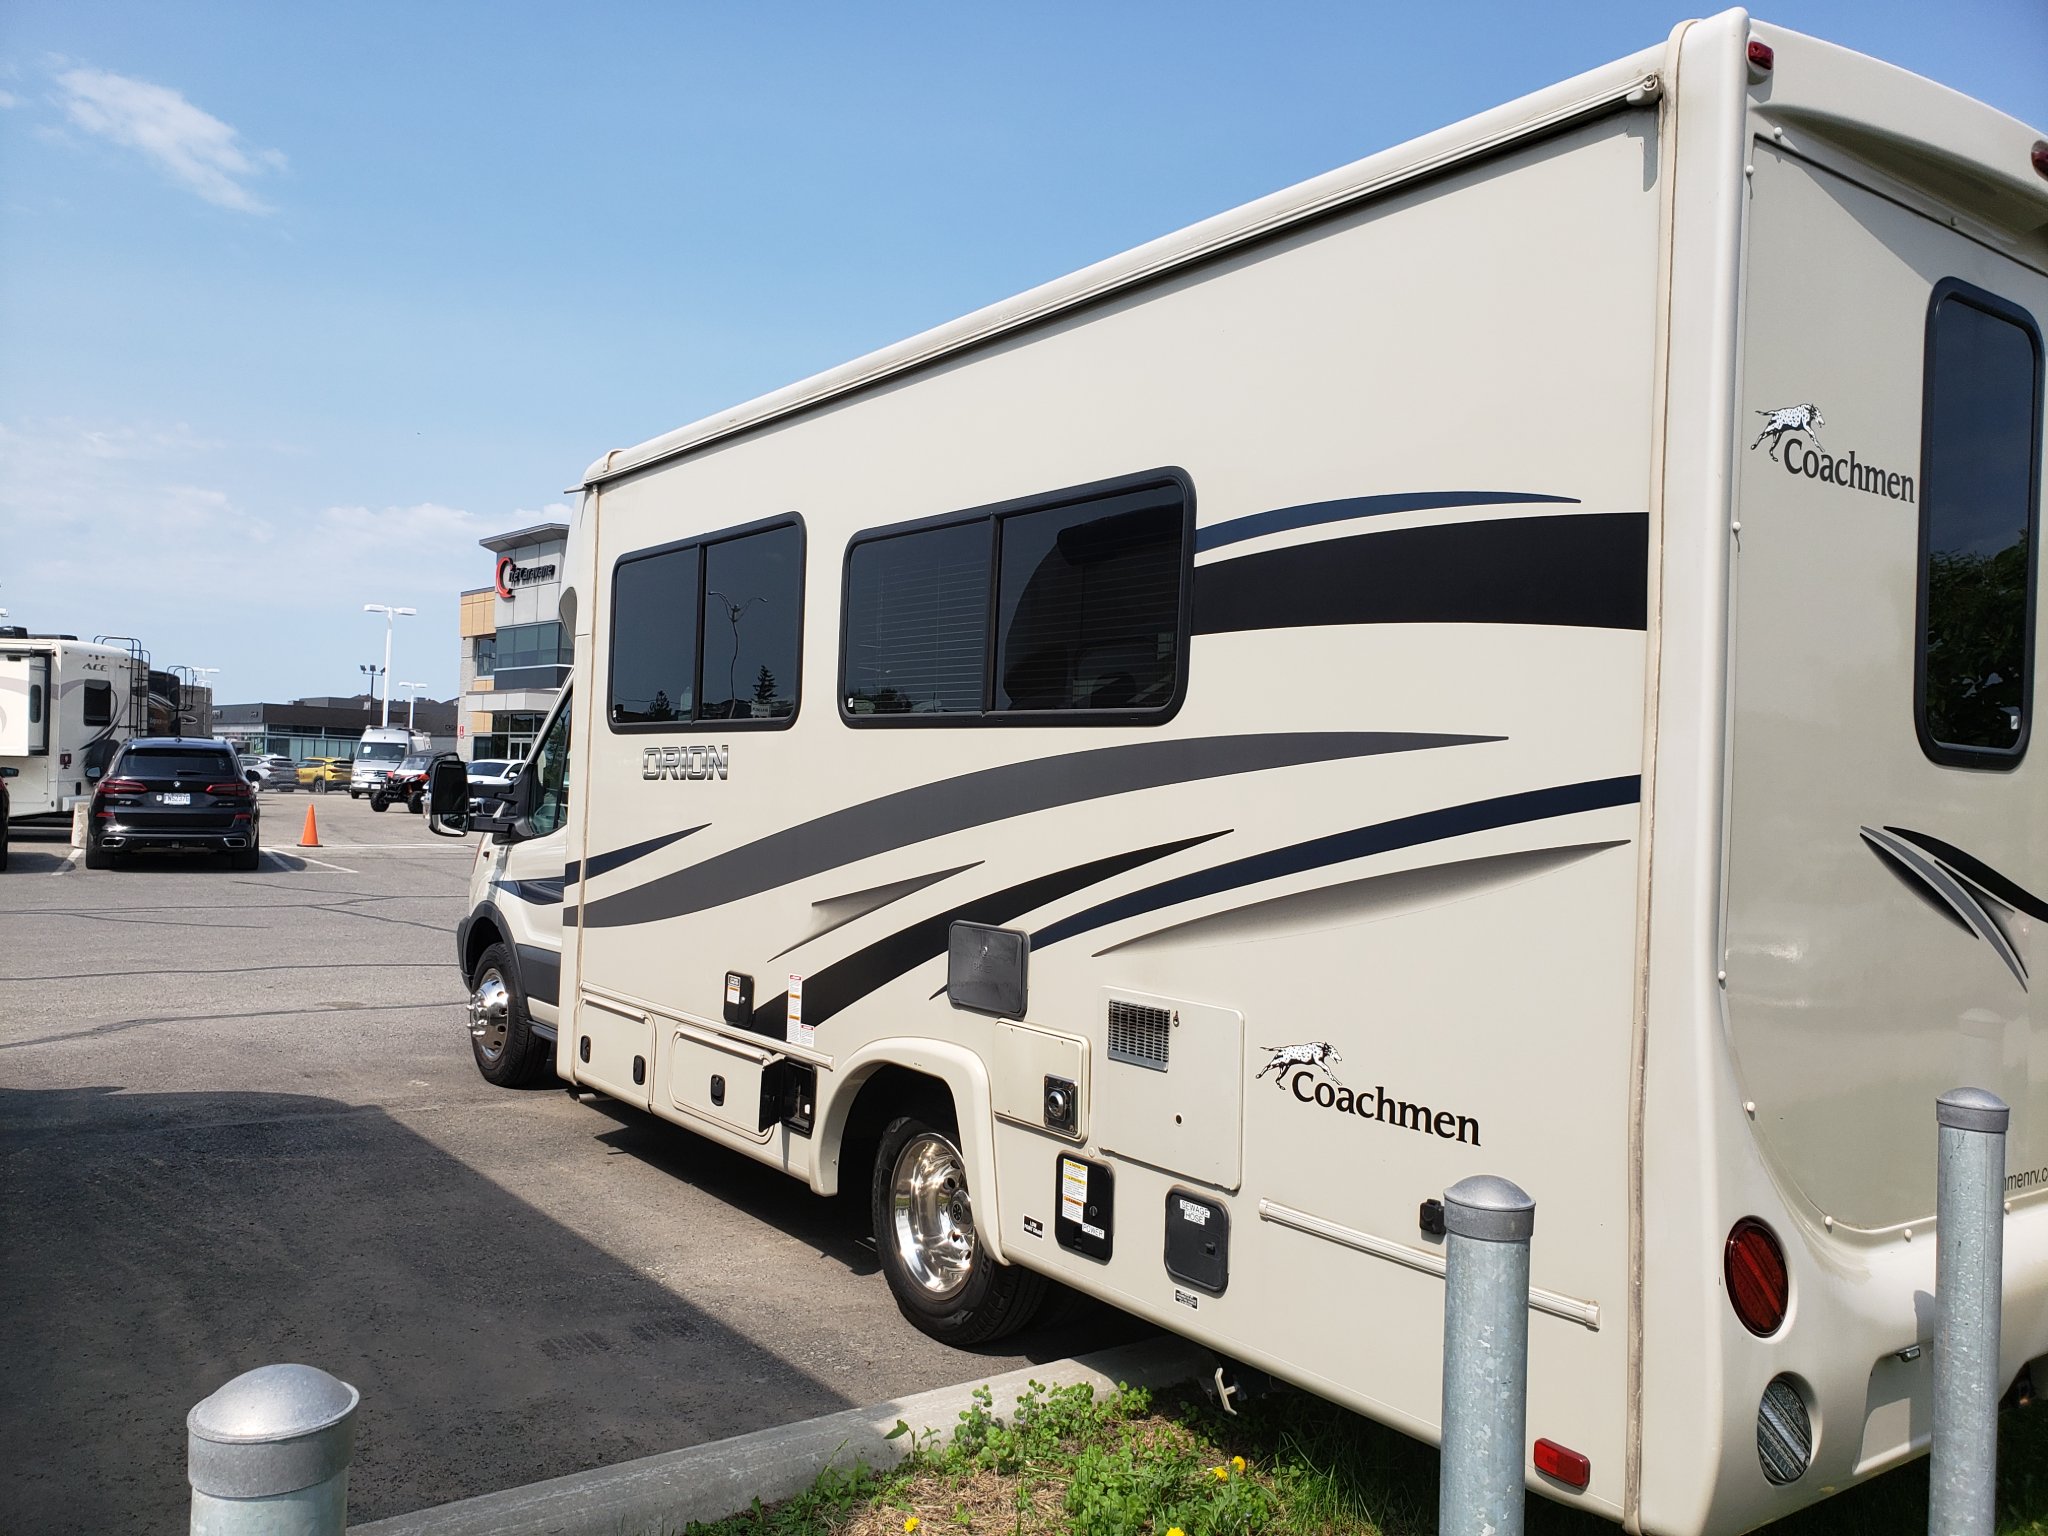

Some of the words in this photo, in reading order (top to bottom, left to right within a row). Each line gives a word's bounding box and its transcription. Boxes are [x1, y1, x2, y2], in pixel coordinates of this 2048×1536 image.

[1783, 438, 1915, 504] Coachmen
[642, 744, 729, 781] ORION
[1291, 1070, 1482, 1147] Coachmen
[1181, 1200, 1210, 1218] SEWAGE
[1185, 1210, 1204, 1225] HOSE
[1082, 1222, 1104, 1238] POWER
